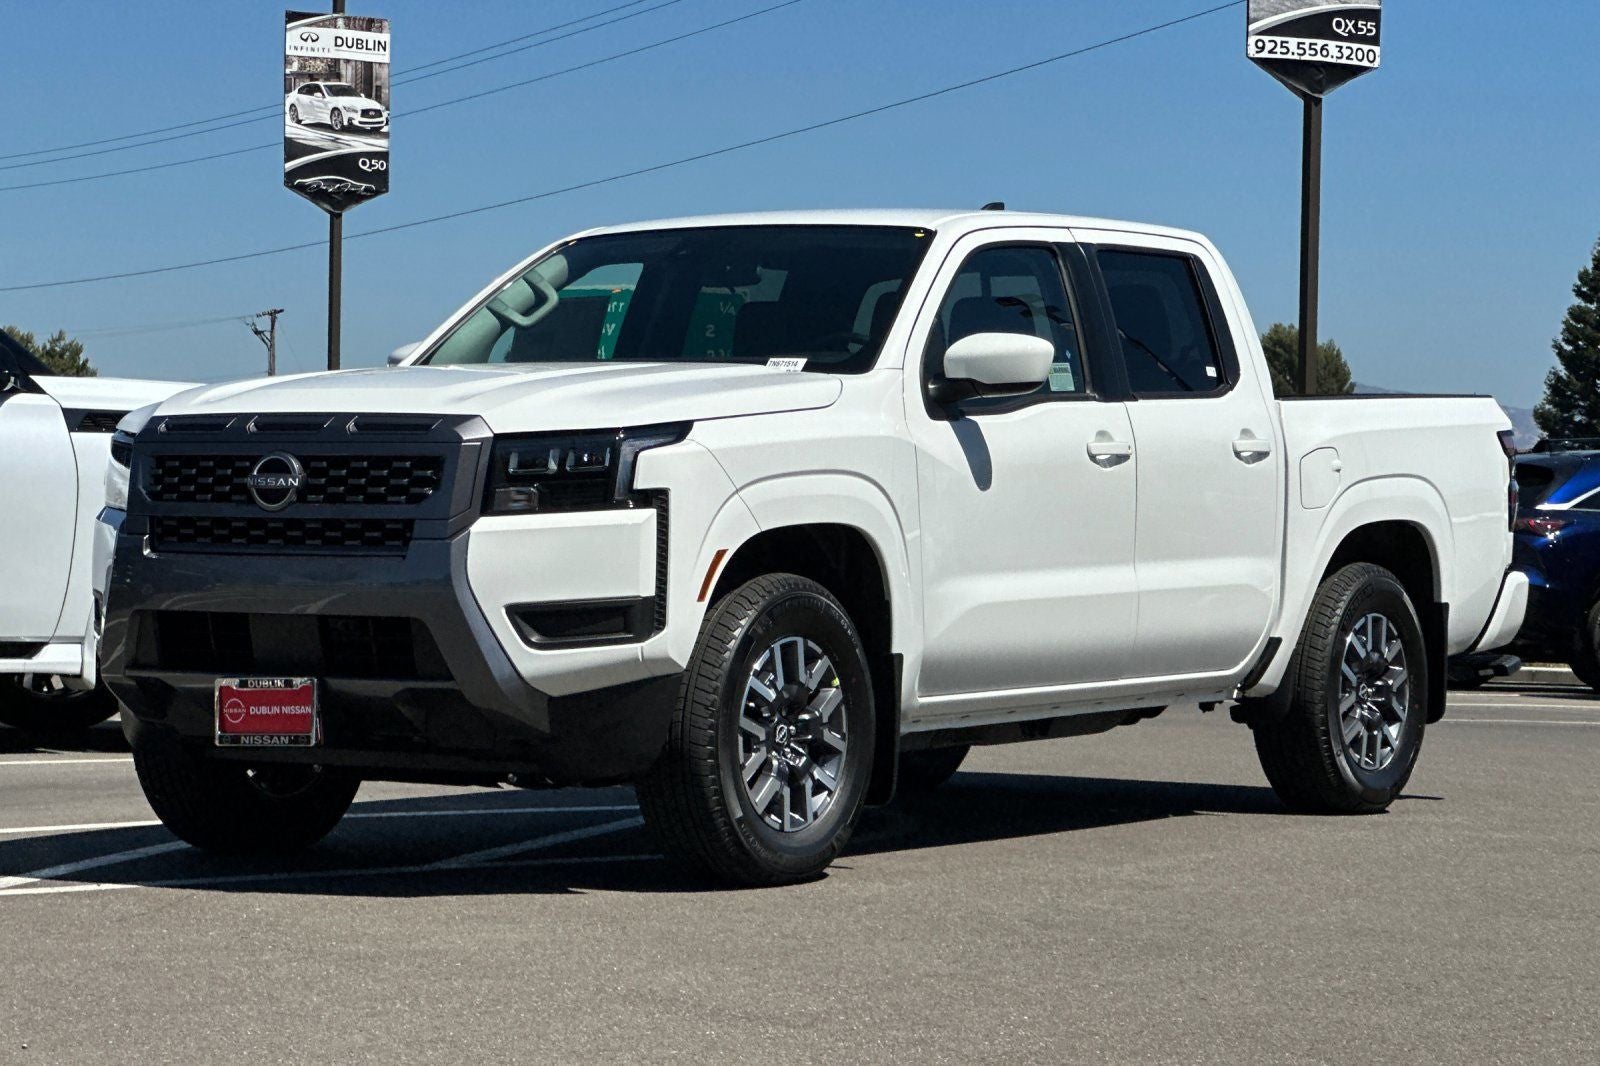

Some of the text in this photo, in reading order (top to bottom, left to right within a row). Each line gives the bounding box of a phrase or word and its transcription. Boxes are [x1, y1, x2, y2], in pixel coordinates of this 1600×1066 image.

[1332, 17, 1377, 37] QX55
[334, 35, 387, 52] DUBLIN
[289, 45, 331, 54] INFINITI
[1254, 38, 1377, 64] 925.556.3200
[358, 157, 387, 172] Q50
[247, 476, 299, 487] NISSAN
[247, 679, 285, 688] DUBLIN
[249, 705, 312, 715] DUBLIN NISSAN
[240, 736, 290, 745] NISSAN
